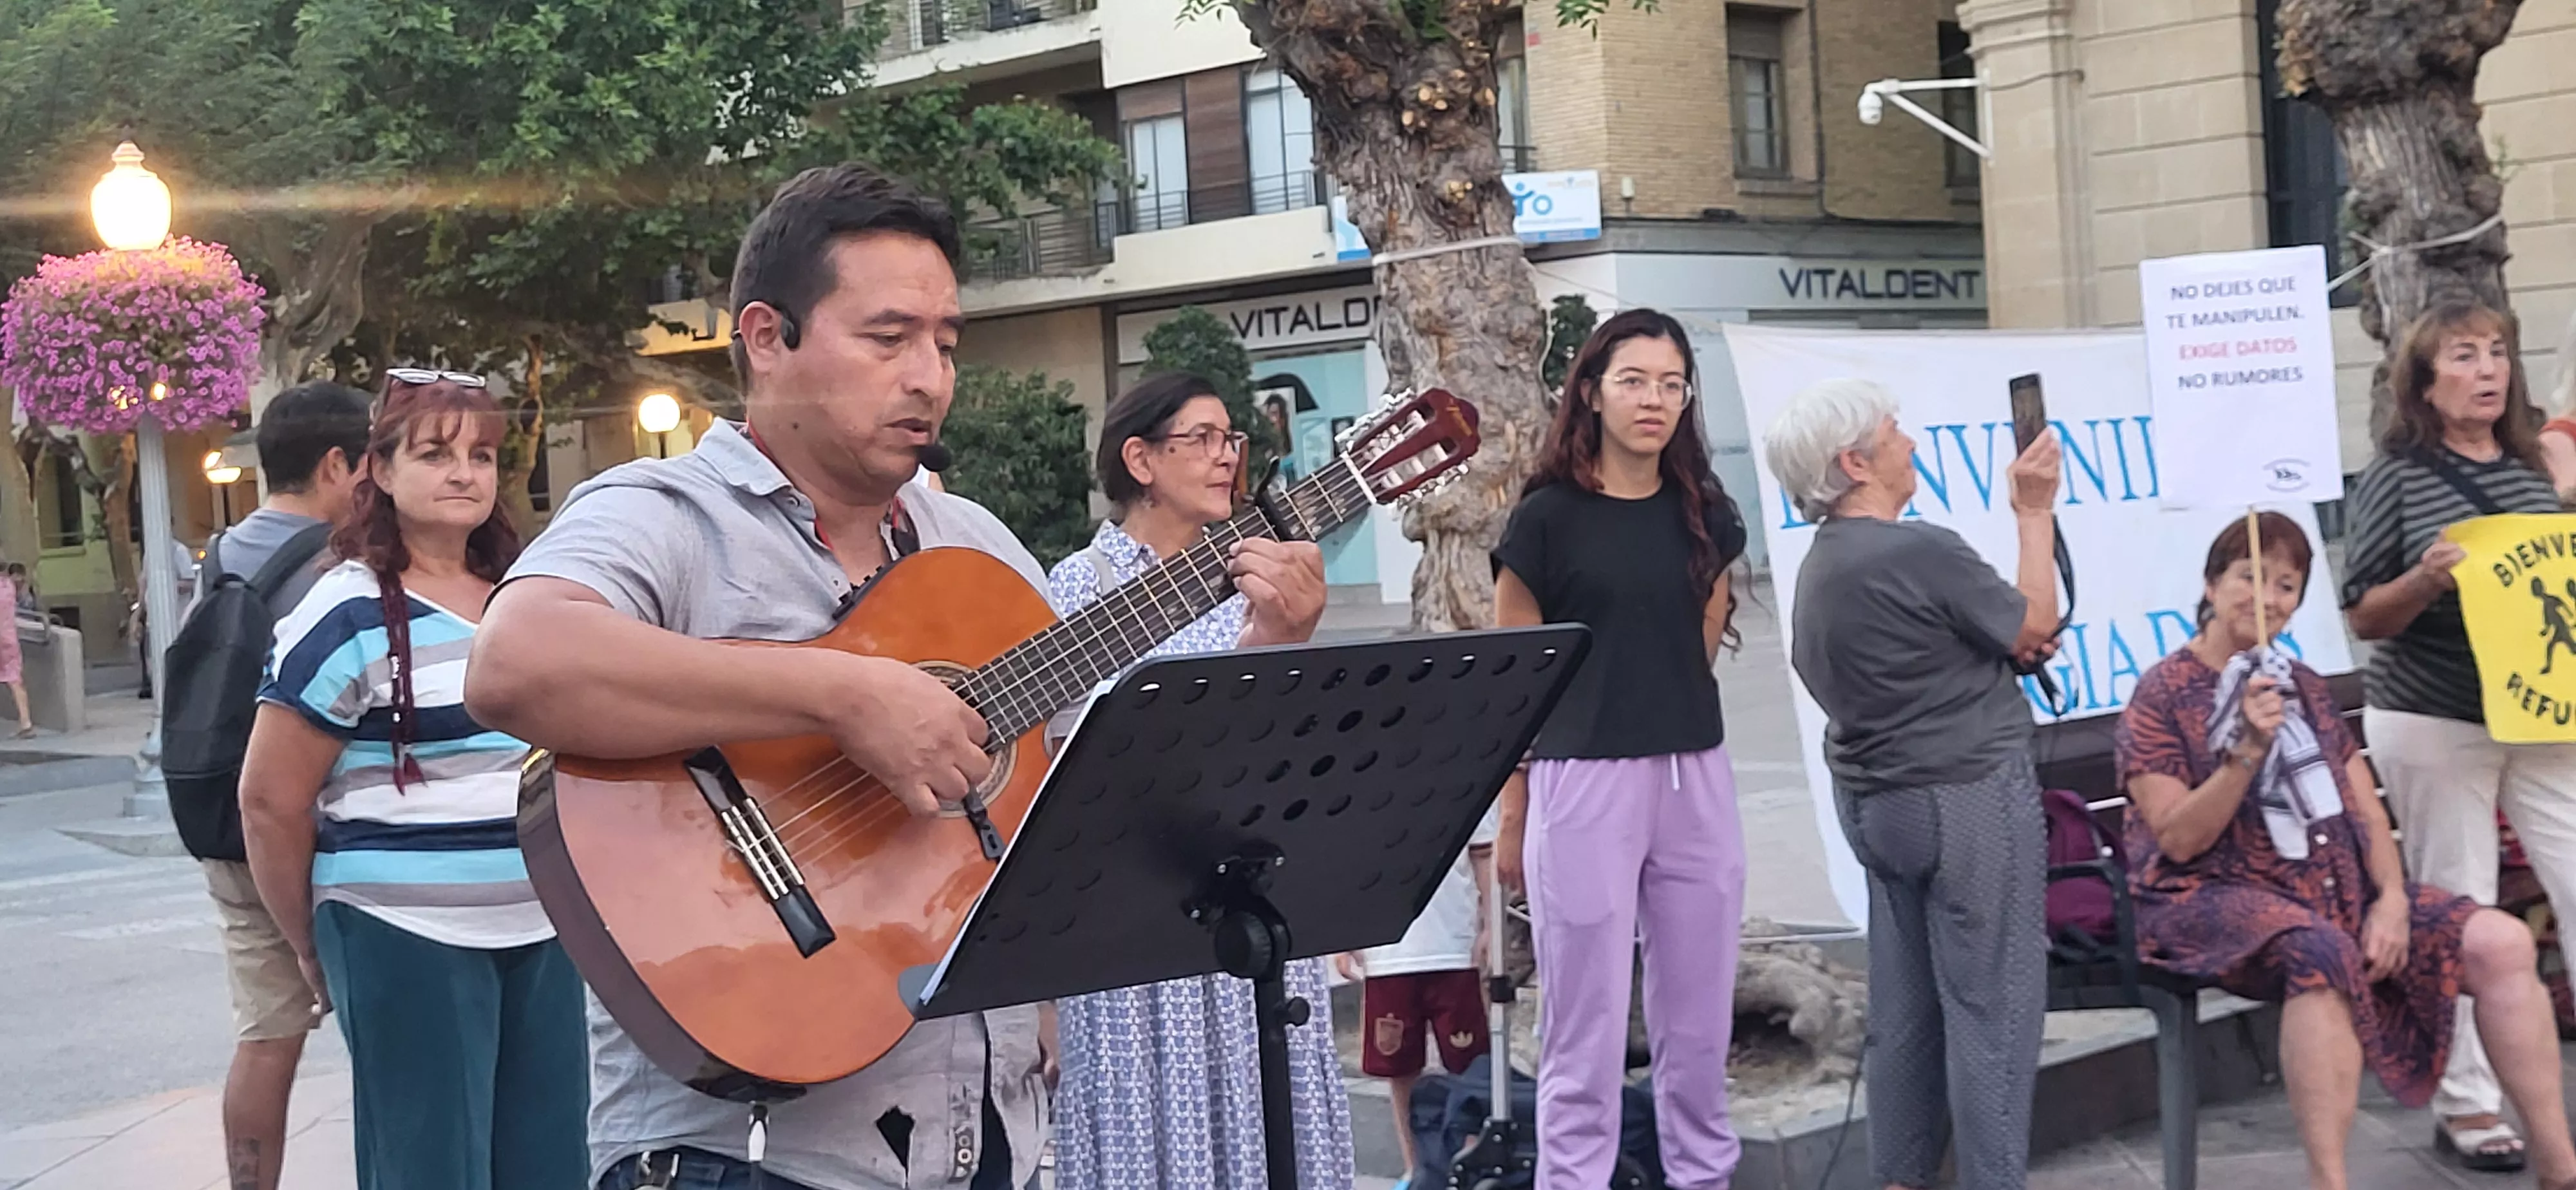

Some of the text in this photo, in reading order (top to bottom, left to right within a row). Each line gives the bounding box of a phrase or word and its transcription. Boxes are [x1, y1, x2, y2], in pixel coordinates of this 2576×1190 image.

[1779, 267, 1980, 300] VITALDENT
[2172, 276, 2297, 300] NO DEJES QUE
[2165, 312, 2186, 328] TE
[2236, 336, 2298, 357] DATOS
[2178, 365, 2304, 390] NO RUMORES
[2506, 672, 2576, 726] REFU
